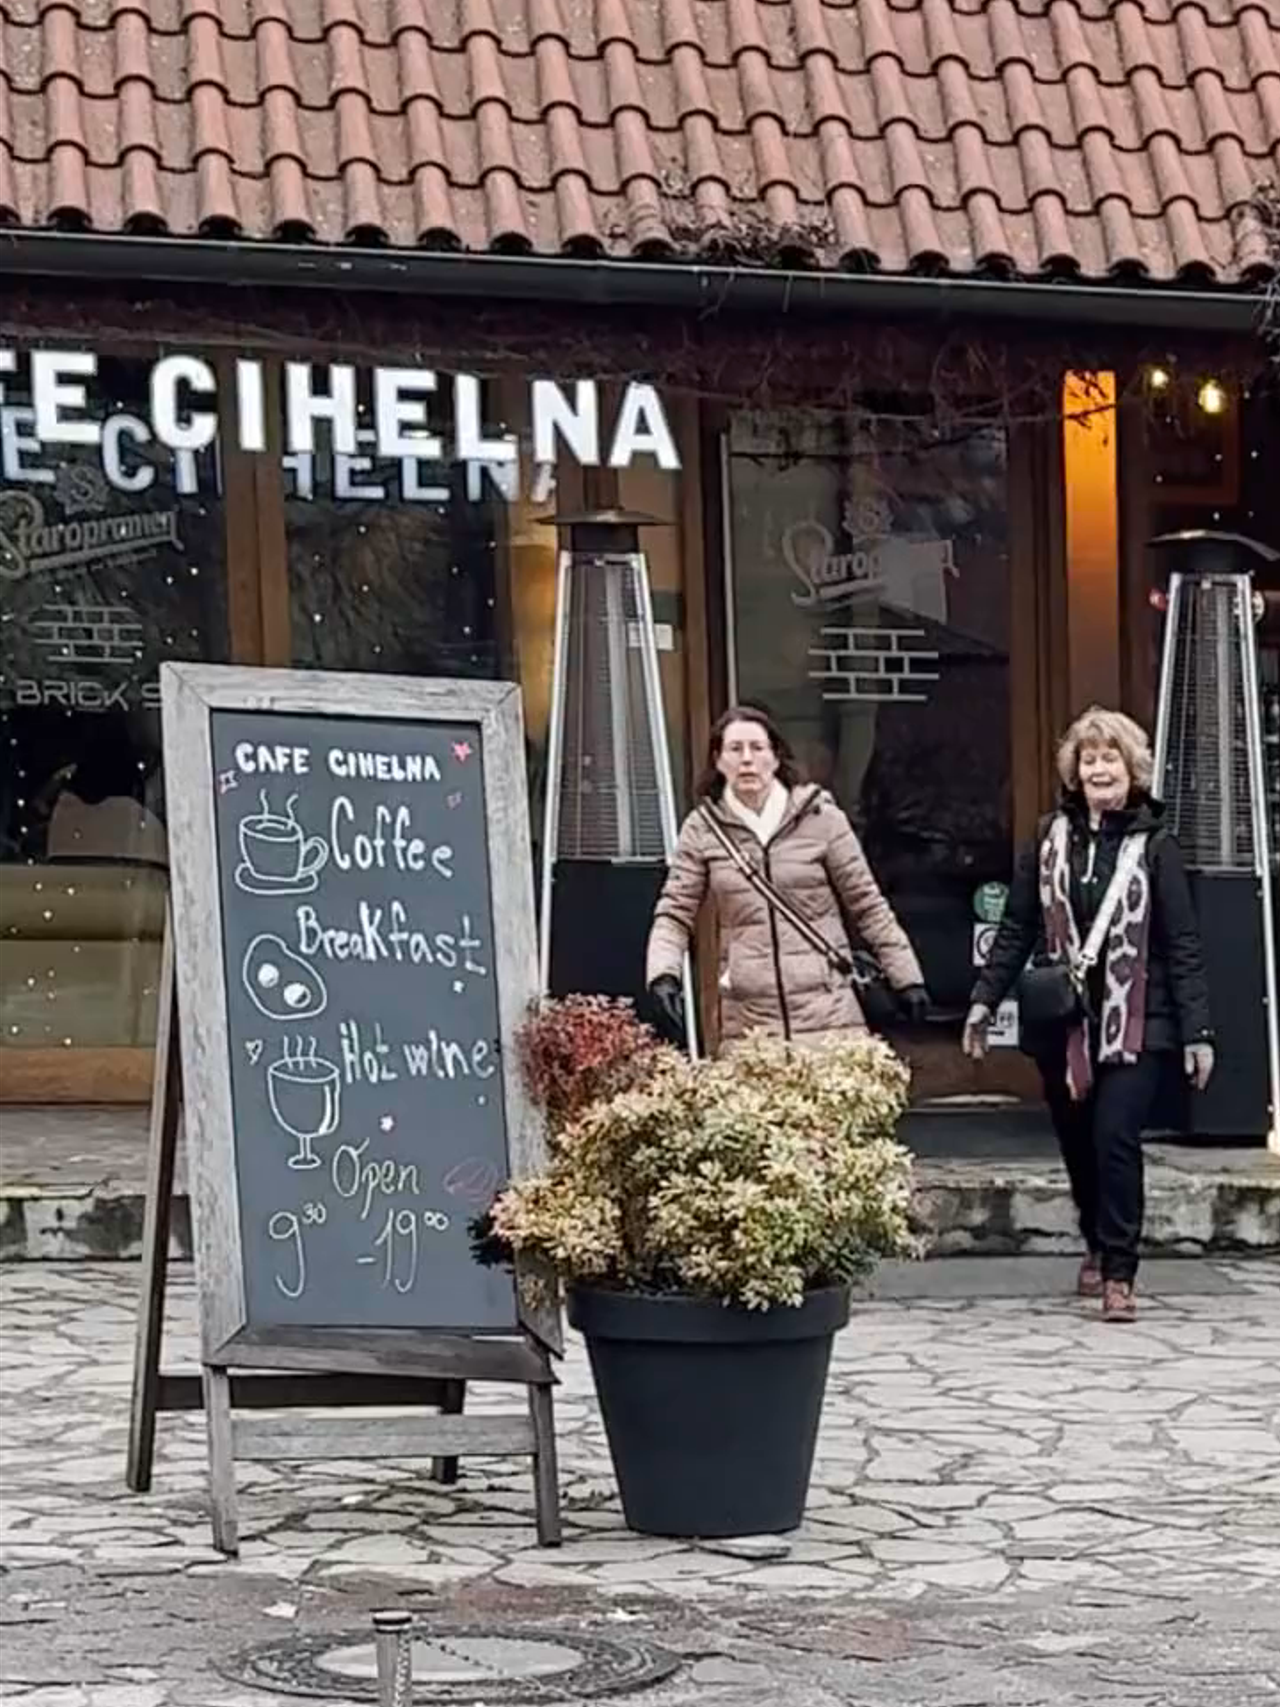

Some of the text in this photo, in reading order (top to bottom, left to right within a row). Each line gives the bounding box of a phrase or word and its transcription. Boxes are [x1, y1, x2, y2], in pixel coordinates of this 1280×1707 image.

[149, 355, 682, 470] CIHELNA
[235, 743, 442, 782] CAFE CIHELNA
[331, 796, 453, 878] Coffee
[339, 1019, 398, 1084] Hot
[332, 1137, 420, 1221] Open
